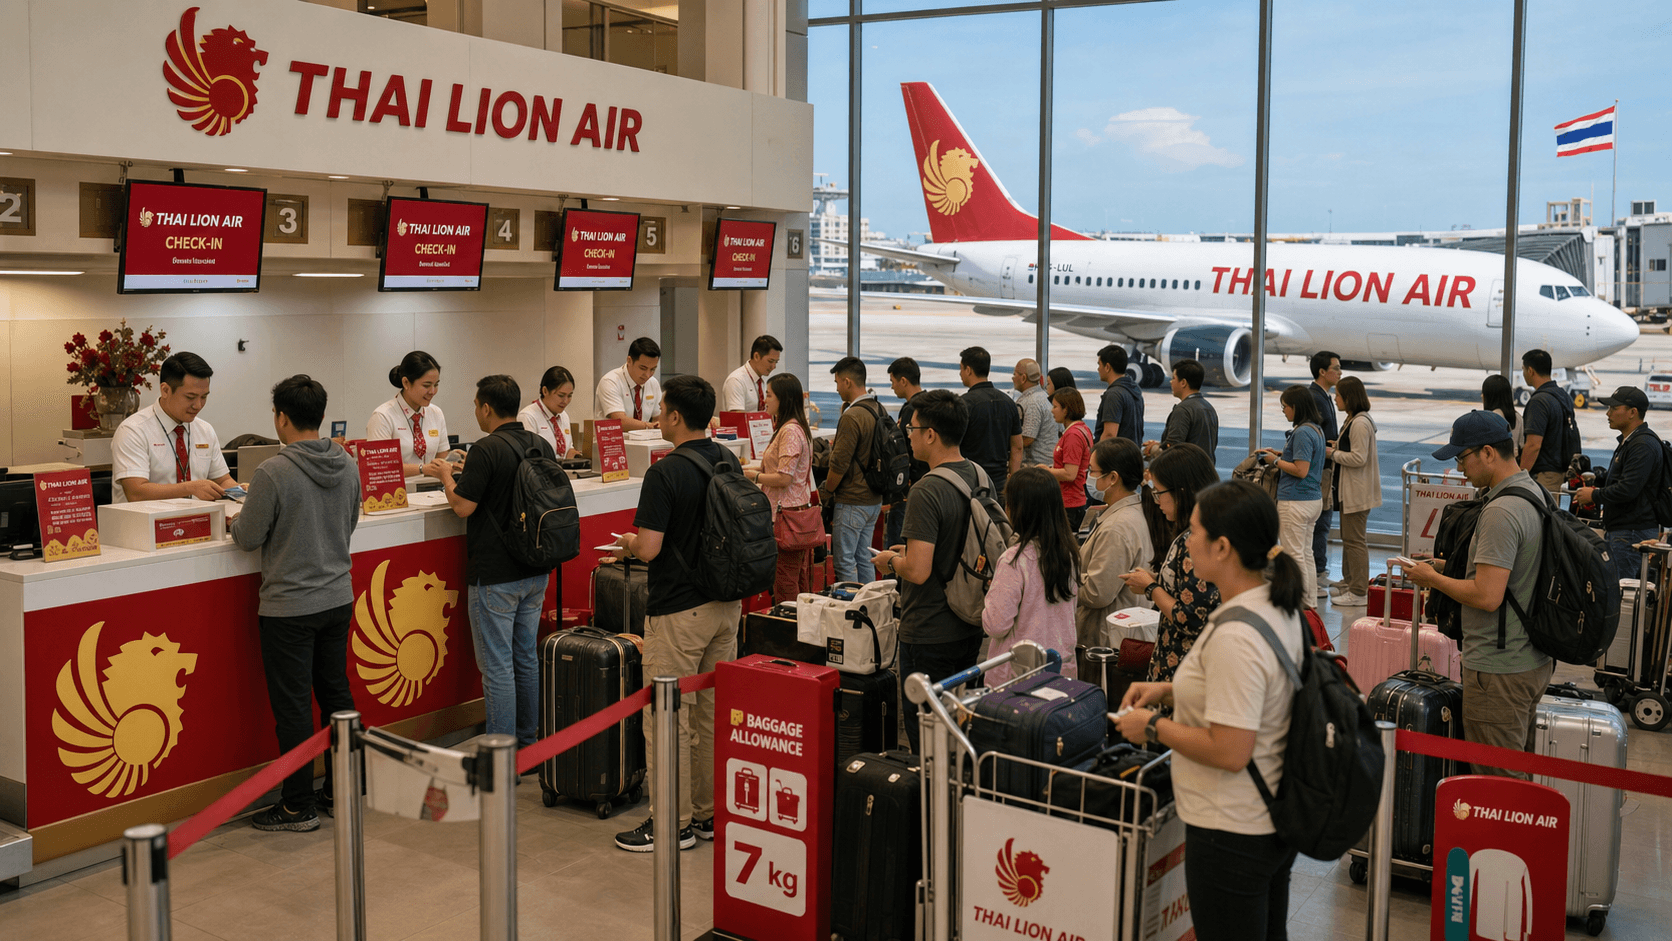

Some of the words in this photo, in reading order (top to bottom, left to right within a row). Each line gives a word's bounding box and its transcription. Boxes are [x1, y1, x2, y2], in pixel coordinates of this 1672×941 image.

[289, 60, 433, 128] THAI
[446, 83, 563, 139] LION
[570, 102, 643, 153] AIR
[0, 192, 22, 223] 2
[156, 212, 188, 226] THAI
[189, 213, 220, 227] LION
[221, 215, 244, 228] AIR
[279, 207, 297, 234] 3
[409, 223, 431, 235] THAI
[432, 224, 454, 236] LION
[455, 225, 471, 236] AIR
[498, 219, 513, 242] 4
[165, 236, 223, 250] CHECK-IN
[580, 230, 597, 241] THAI
[597, 231, 614, 242] LION
[614, 232, 627, 242] AIR
[646, 226, 658, 247] 5
[791, 236, 800, 254] 6
[414, 243, 457, 255] CHECK-IN
[1300, 269, 1395, 304] LION
[1401, 273, 1477, 309] AIR
[1415, 490, 1435, 499] THAI
[1435, 491, 1455, 500] LION
[746, 713, 803, 738] BAGGAGE
[730, 728, 803, 757] ALLOWANCE
[1473, 806, 1502, 821] THAI
[1504, 810, 1534, 825] LION
[1535, 815, 1558, 829] AIR
[734, 840, 763, 885] 7
[768, 861, 798, 898] kg
[974, 905, 1011, 930] THAI
[1014, 918, 1053, 941] LION
